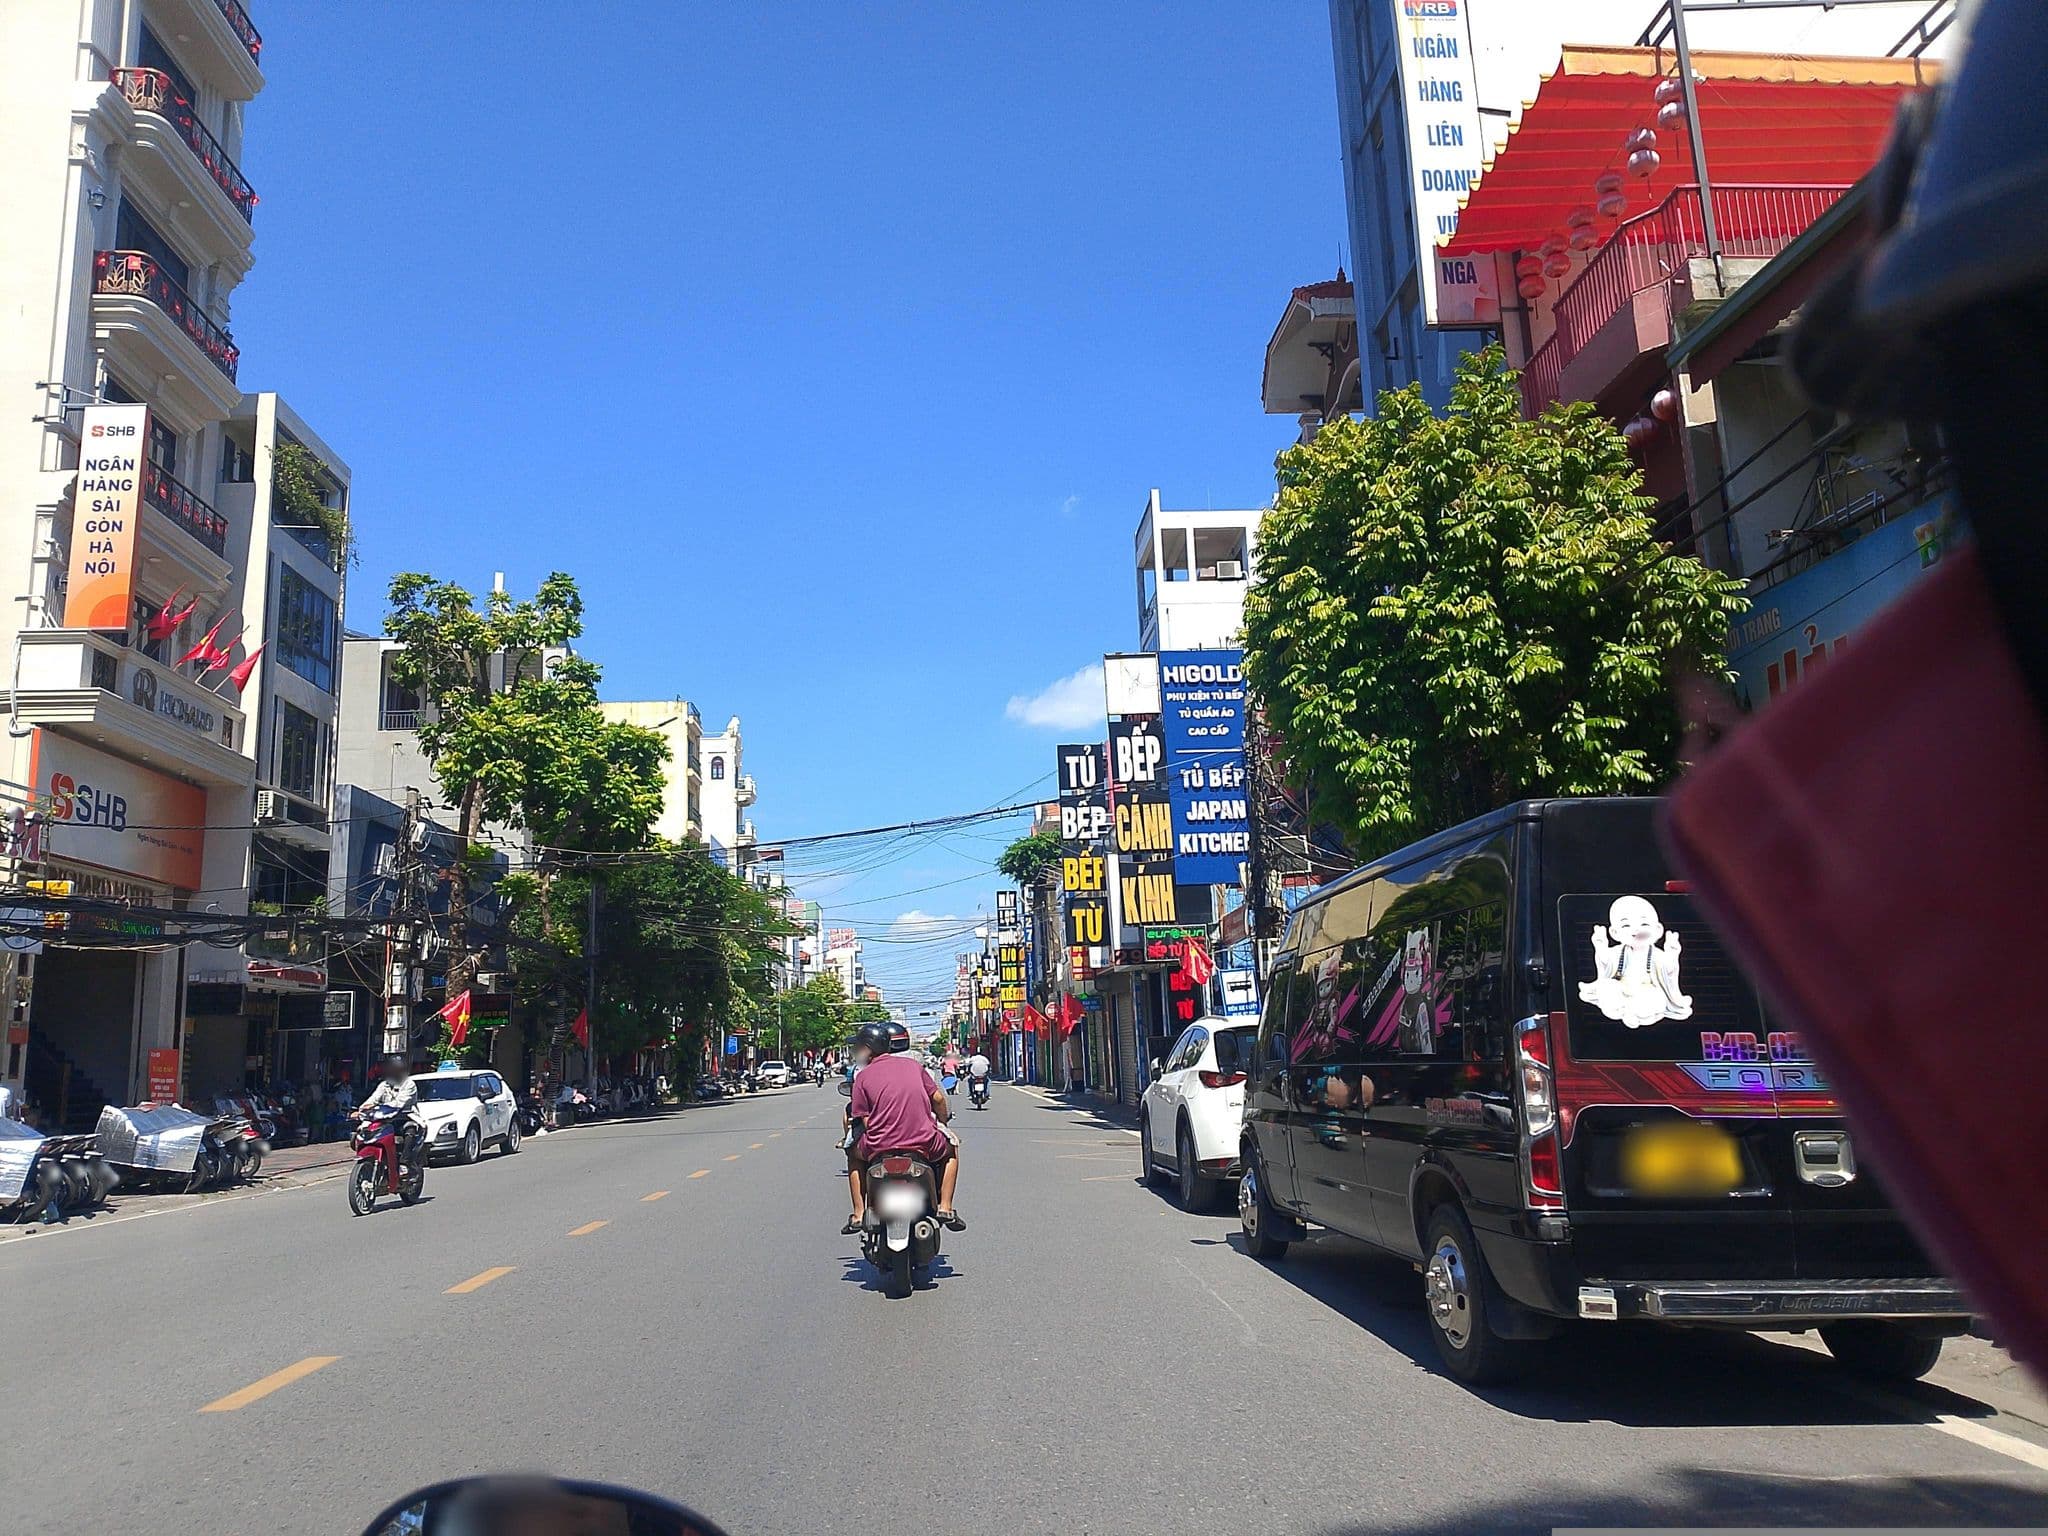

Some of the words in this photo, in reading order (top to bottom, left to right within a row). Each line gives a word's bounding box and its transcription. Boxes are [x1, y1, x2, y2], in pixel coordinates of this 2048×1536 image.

[1413, 33, 1458, 58] NGÂN
[1418, 76, 1463, 102] HÀNG
[1427, 120, 1463, 146] LIÊN
[1441, 261, 1477, 284] NGA
[85, 455, 135, 471] NGÂN
[83, 475, 133, 492] HÀNG
[92, 496, 121, 512] SÀI
[85, 516, 123, 533] GÒN
[89, 537, 114, 554] HÀ
[85, 558, 116, 577] NỘI
[1742, 607, 1781, 644] TRANG
[1163, 664, 1243, 684] HIGOLD
[1166, 692, 1187, 703] PHỤ
[1178, 706, 1192, 718] TỦ
[1220, 706, 1236, 717] ÁO
[1188, 727, 1209, 736] CAO
[1209, 723, 1230, 736] CẤP
[1116, 721, 1161, 782] BẾP
[1065, 745, 1097, 788] TỦ
[1180, 762, 1204, 788] TỦ
[1208, 761, 1245, 787] BẾP
[76, 784, 128, 833] SHB
[1061, 795, 1107, 839] BẾP
[1186, 799, 1247, 820] JAPAN
[1115, 794, 1173, 852] CÁNH
[1121, 864, 1176, 924] KÍNH
[1071, 901, 1105, 943] TỪ
